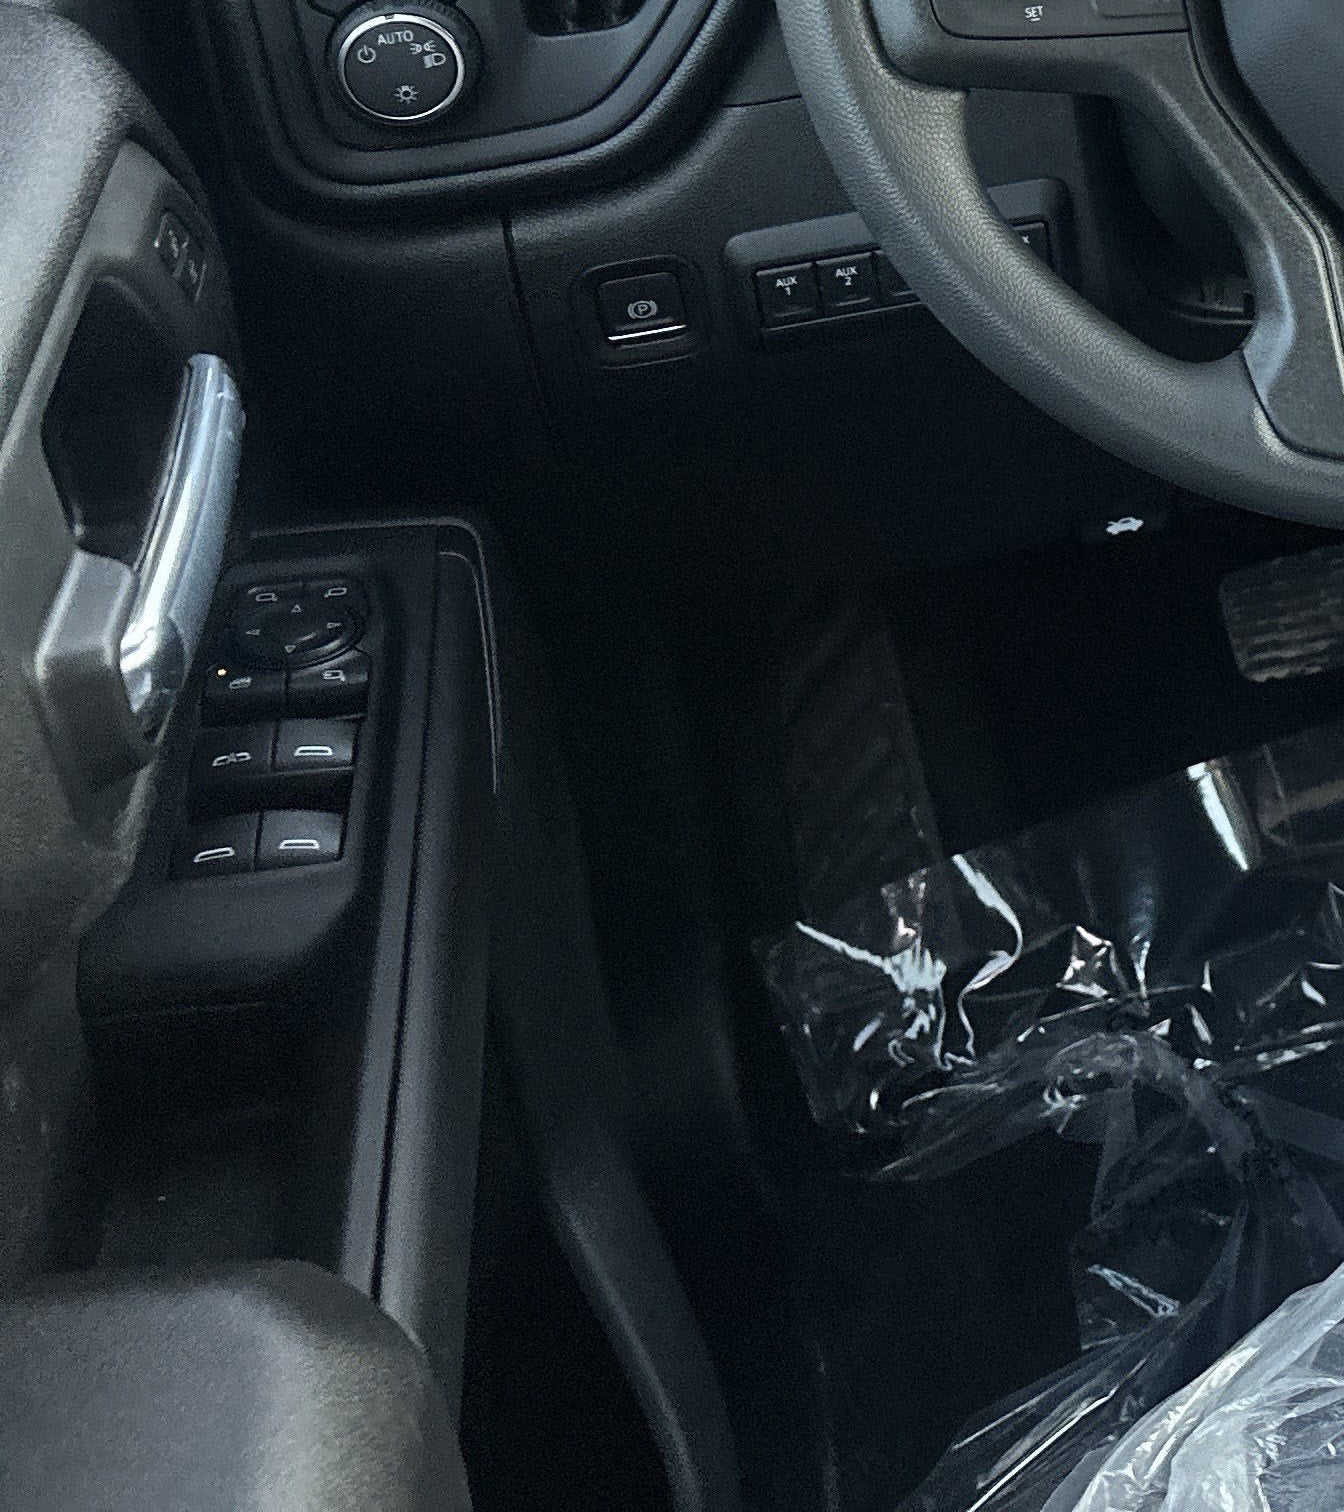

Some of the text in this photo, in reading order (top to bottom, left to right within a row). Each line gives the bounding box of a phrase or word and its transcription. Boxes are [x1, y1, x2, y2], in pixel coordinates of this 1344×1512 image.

[1024, 5, 1044, 19] SET
[377, 29, 413, 46] AUTO
[835, 266, 858, 279] AUX
[775, 275, 797, 289] AUX
[844, 275, 854, 286] 2
